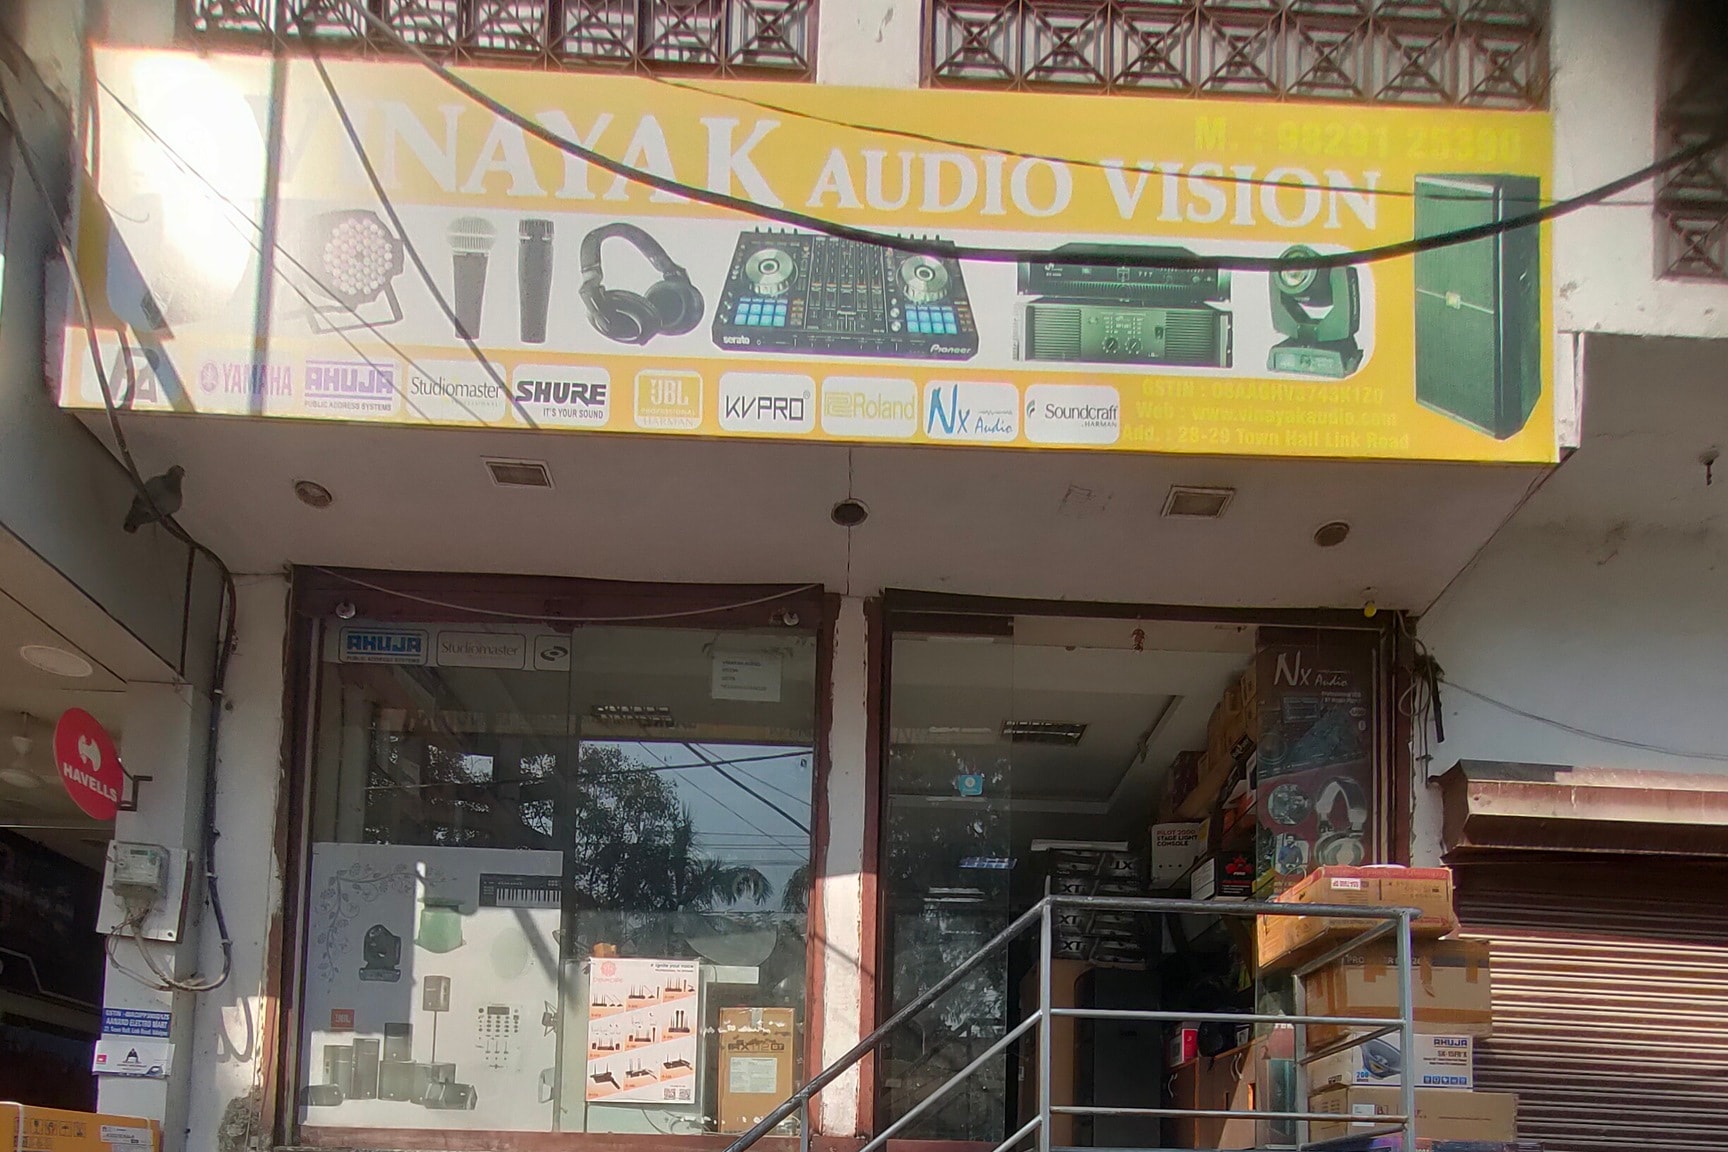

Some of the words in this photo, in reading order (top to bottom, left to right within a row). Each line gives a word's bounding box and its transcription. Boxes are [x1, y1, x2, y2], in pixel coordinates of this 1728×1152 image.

[1277, 121, 1388, 158] 98291
[1407, 127, 1521, 162] 25390
[805, 147, 1073, 218] AUDIO
[1100, 159, 1383, 231] VISION
[723, 336, 749, 344] serato
[930, 344, 971, 354] Pioneer
[223, 362, 292, 396] YAMAHA
[305, 366, 394, 394] AHUJA
[410, 376, 501, 399] Studiomaster
[515, 380, 607, 406] SHURE
[304, 400, 328, 409] PUBLIC
[329, 401, 360, 410] ADDRESS
[361, 403, 392, 411] SYSTEMS
[558, 409, 577, 418] YOUR
[579, 409, 603, 419] SOUND
[726, 395, 804, 421] KVPRO
[852, 393, 915, 420] Roland
[1045, 404, 1118, 420] Soundcraft
[643, 418, 693, 427] HARMAN
[975, 415, 1013, 434] Audio
[1178, 427, 1230, 444] 28-29
[1237, 429, 1279, 445] Town
[1286, 430, 1318, 446] Hall
[1367, 433, 1409, 449] Road
[347, 635, 421, 652] AHUJA
[441, 641, 518, 656] Studiomaster
[1314, 673, 1348, 687] Audio
[63, 762, 118, 802] HAVELLS
[1433, 1038, 1468, 1047] AHUJA
